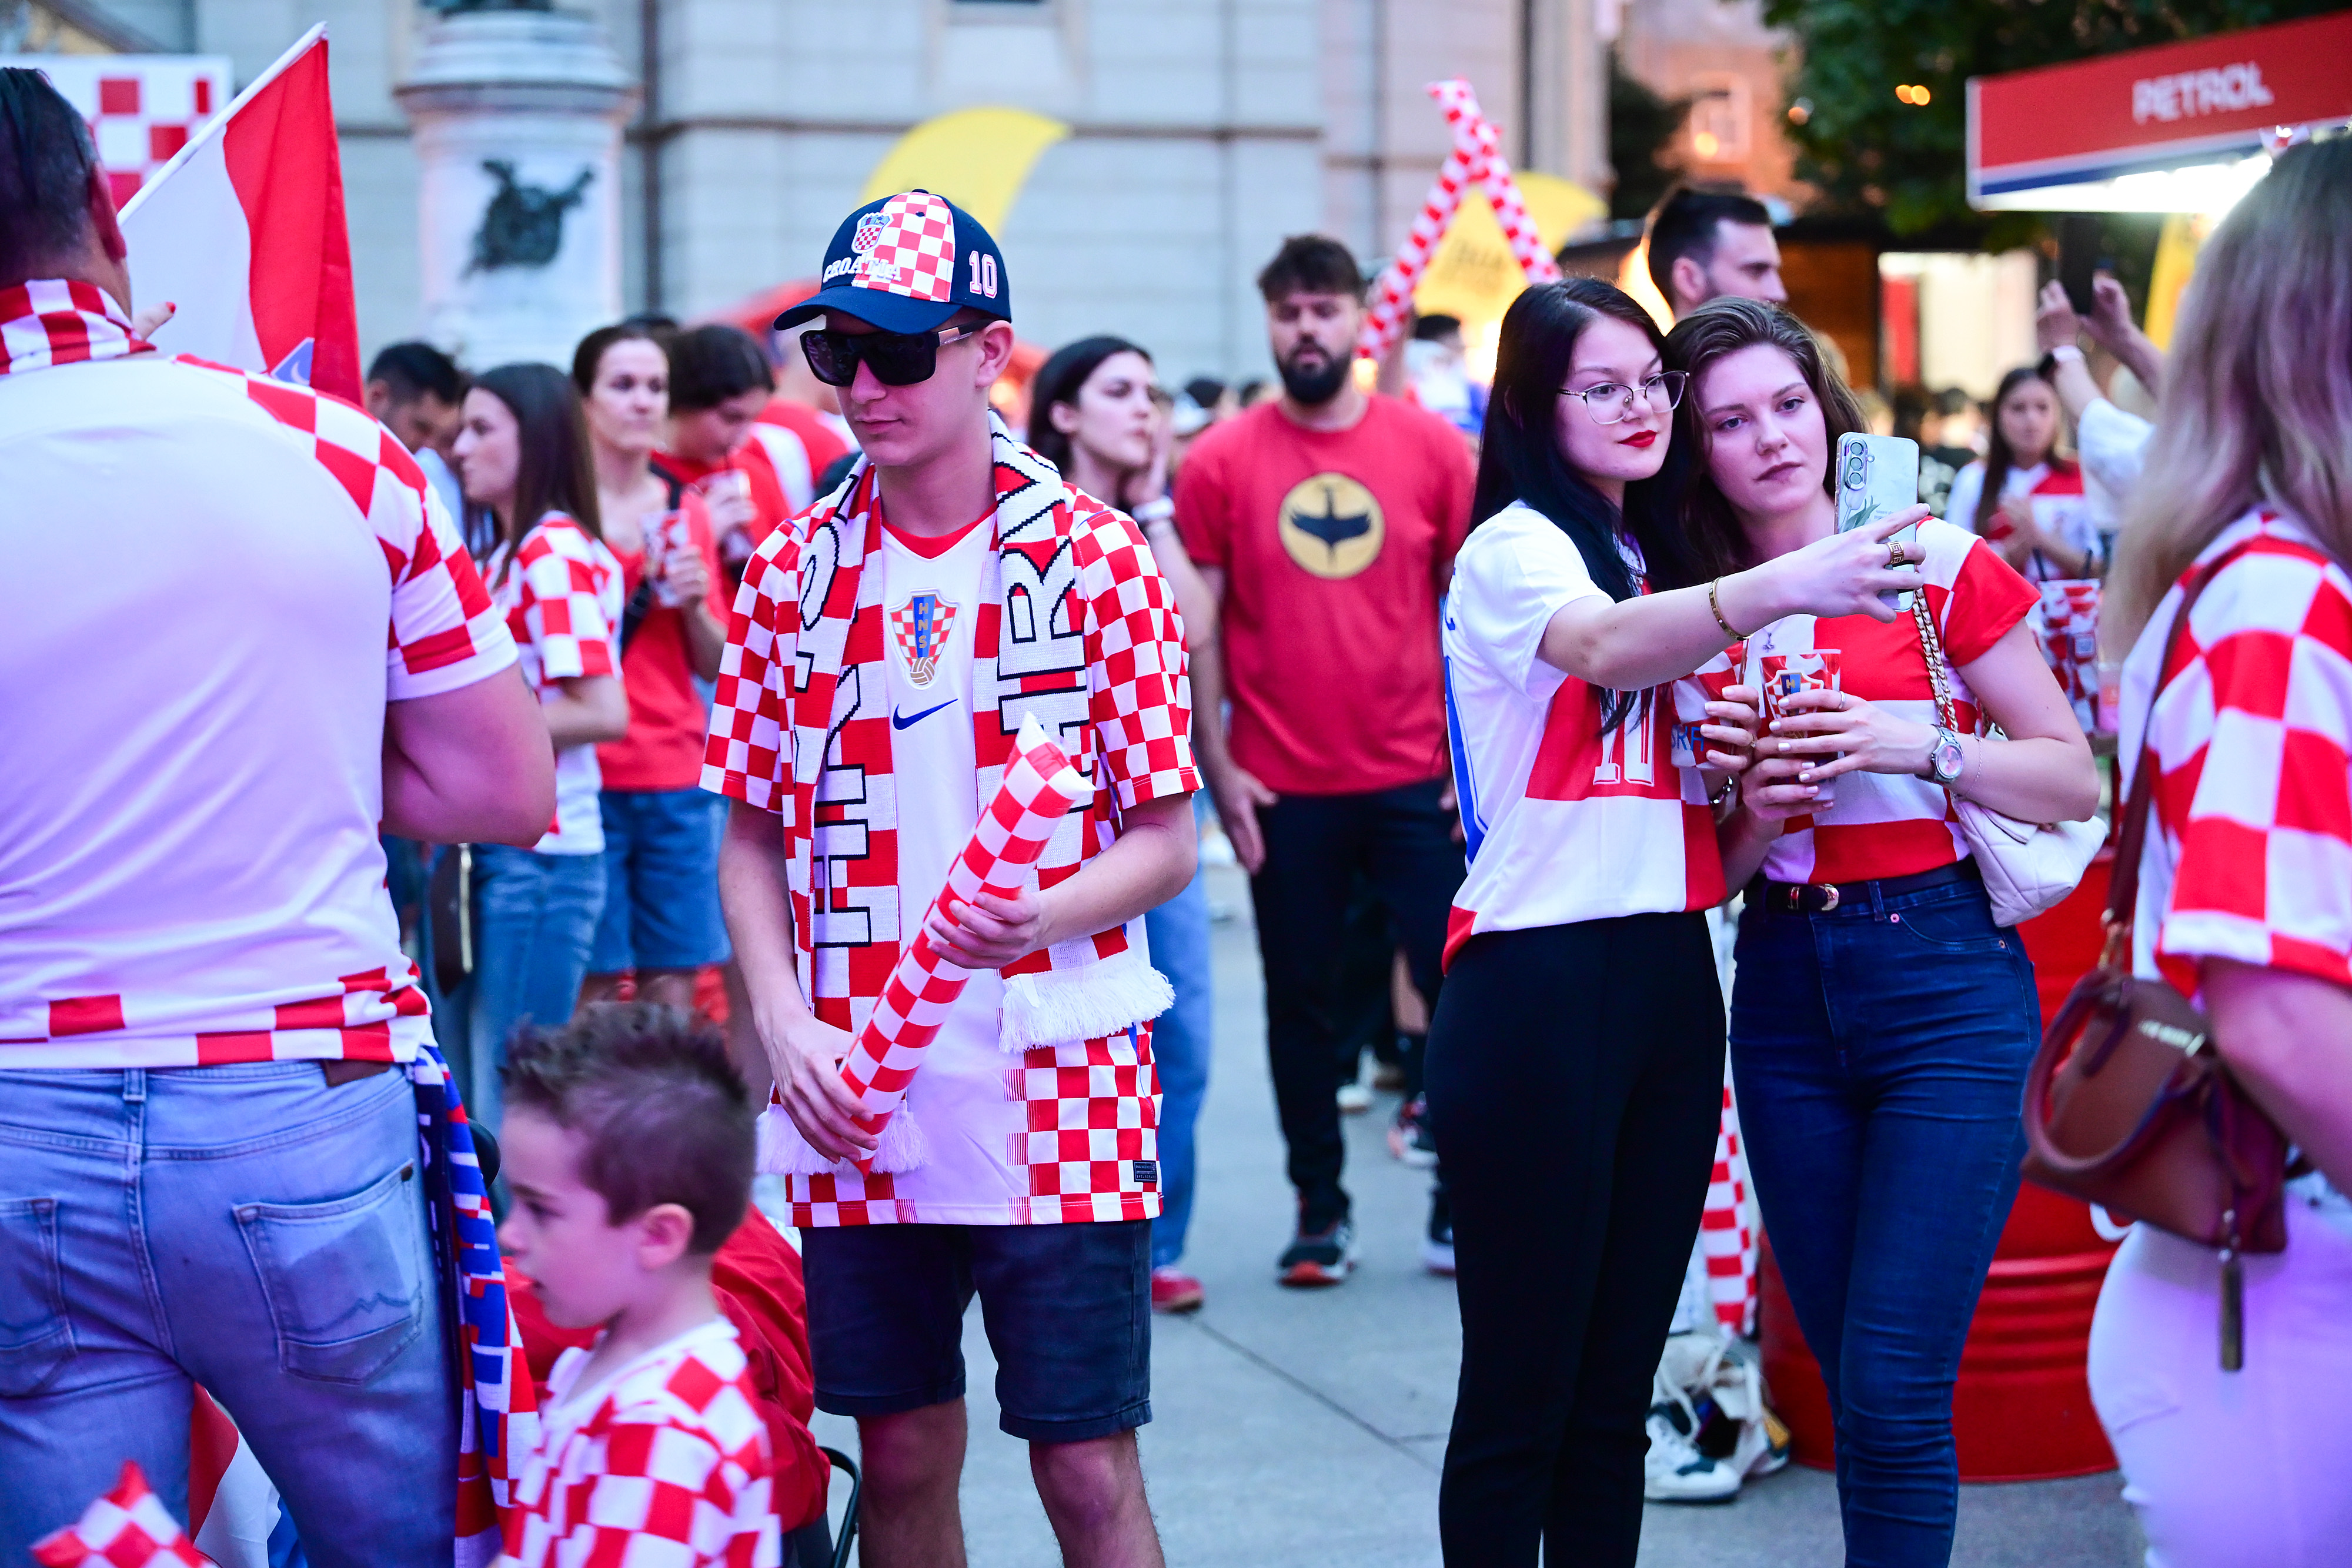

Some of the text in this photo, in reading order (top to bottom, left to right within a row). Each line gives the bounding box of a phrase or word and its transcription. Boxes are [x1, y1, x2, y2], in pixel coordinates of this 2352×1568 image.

[2132, 61, 2274, 125] PETROL
[823, 255, 902, 283] CROATIA
[968, 250, 998, 299] 10
[918, 603, 928, 648] HNS
